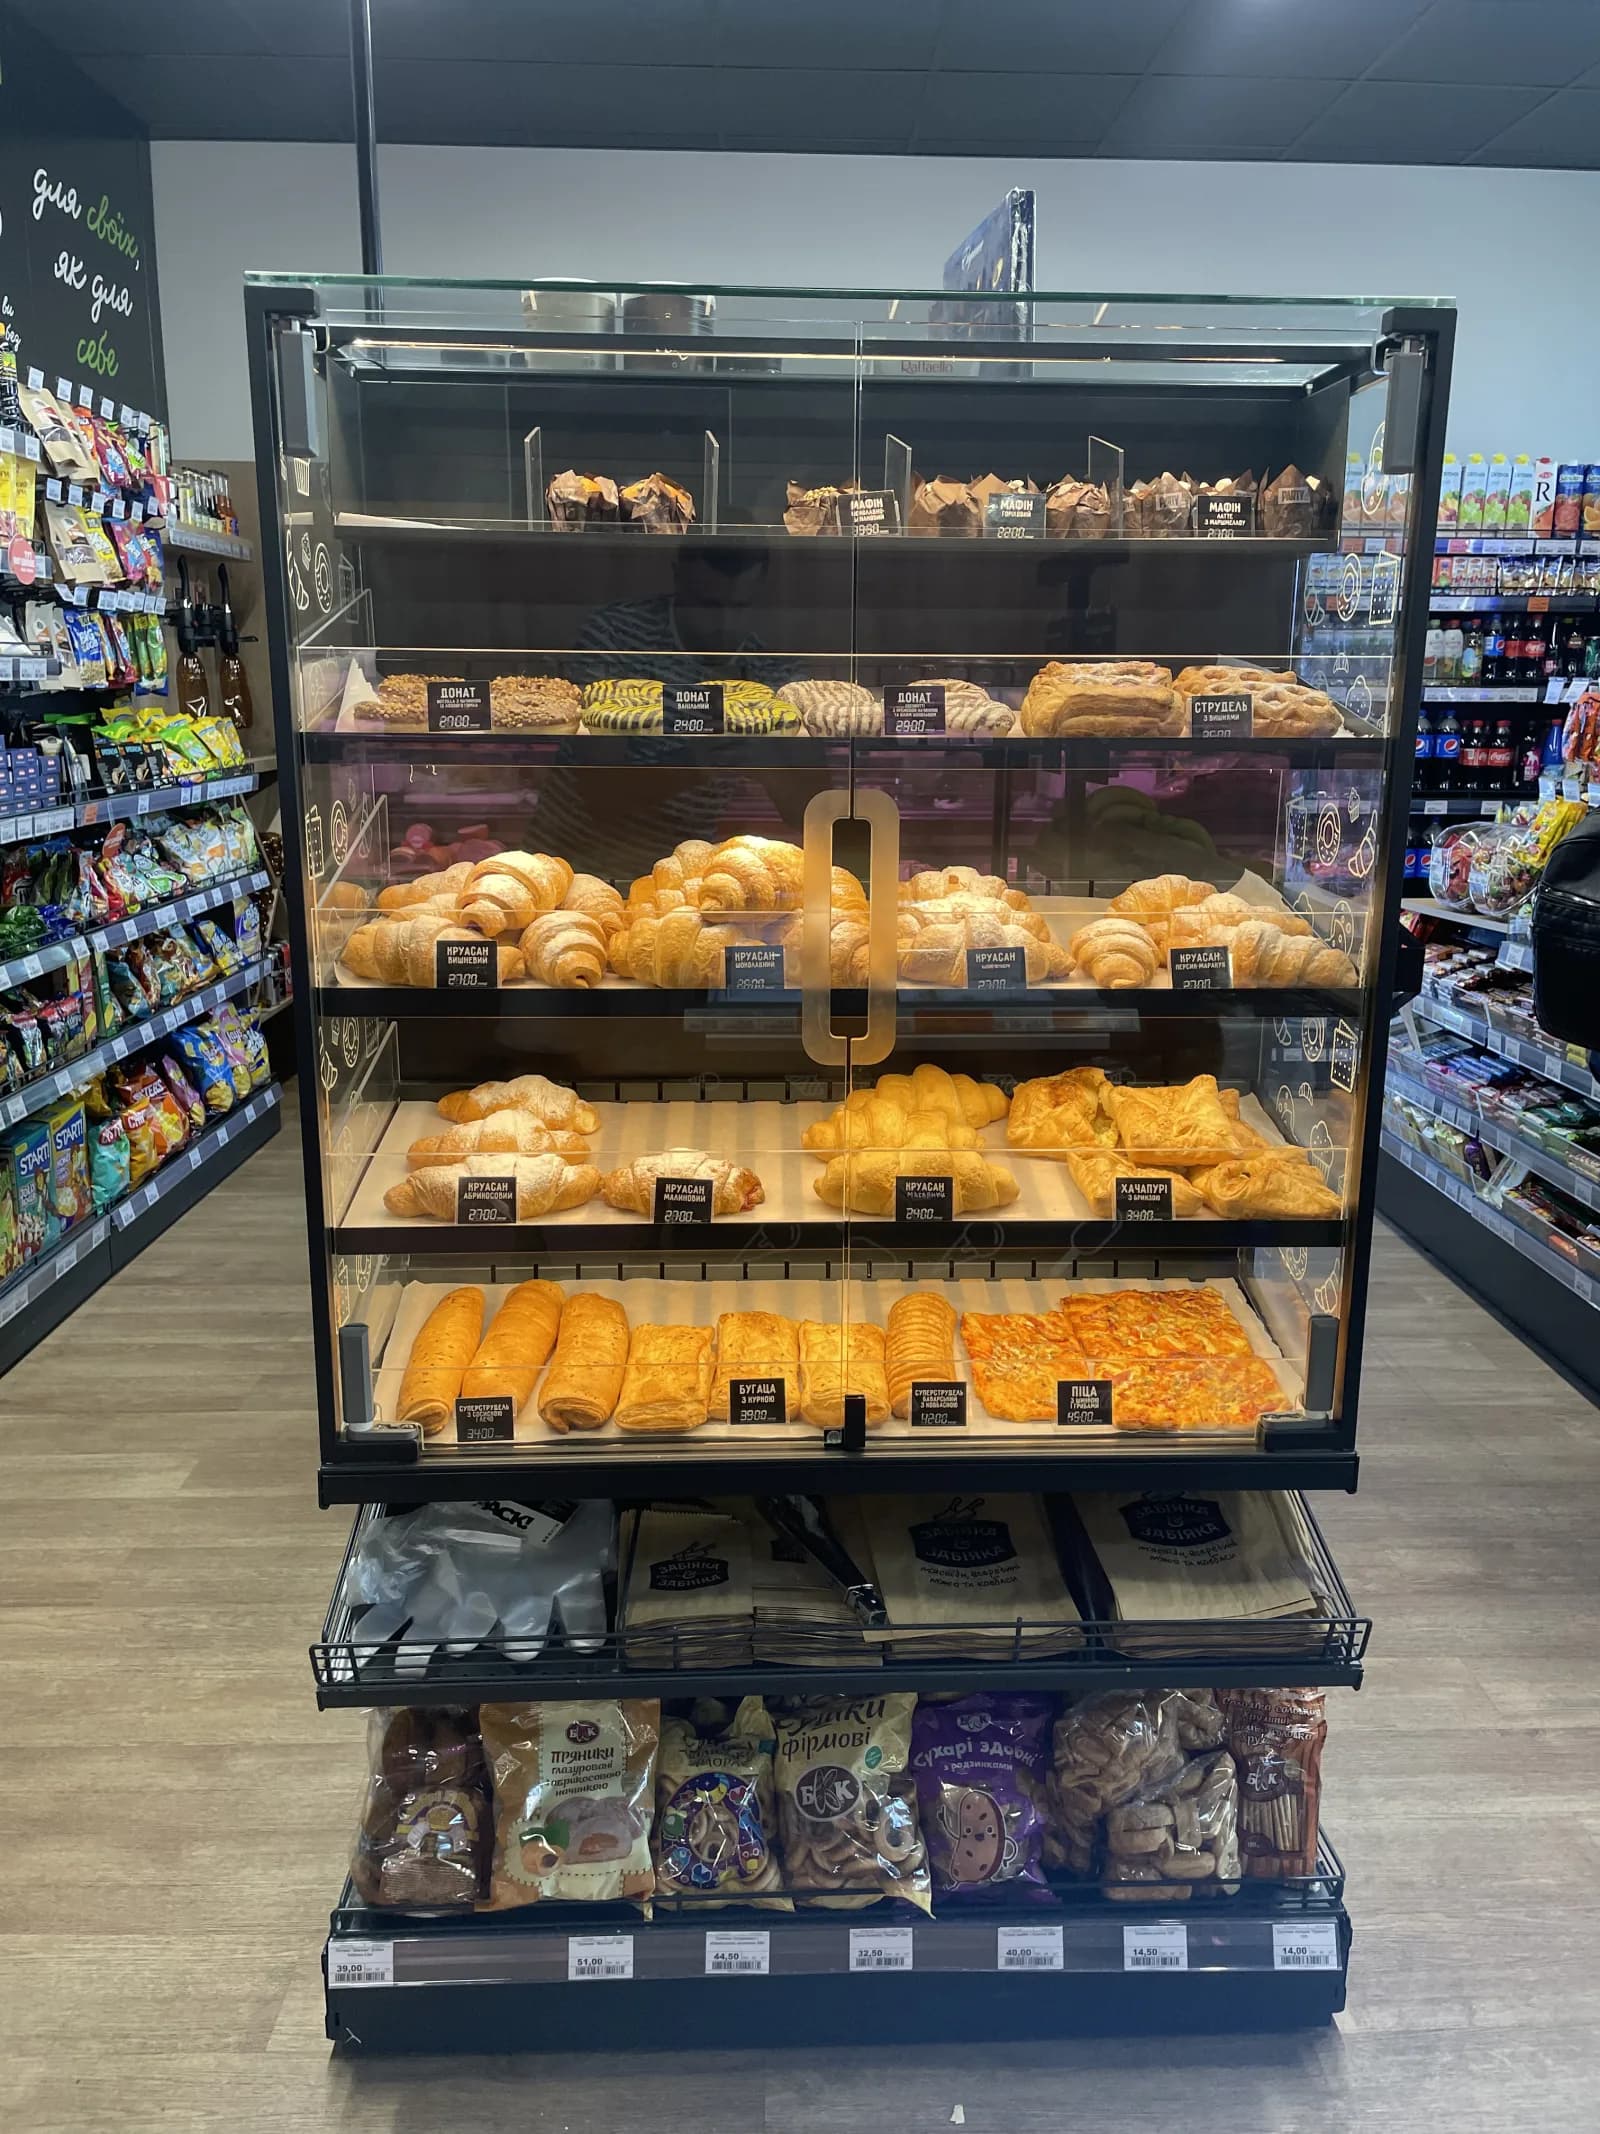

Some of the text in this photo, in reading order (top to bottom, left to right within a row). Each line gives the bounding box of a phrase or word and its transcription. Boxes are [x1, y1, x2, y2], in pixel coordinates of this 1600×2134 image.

[33, 168, 82, 221] для
[54, 251, 133, 323] як для
[76, 329, 119, 377] себе
[1000, 499, 1034, 511] МАФІН
[1209, 502, 1242, 513] МАФІН
[440, 687, 476, 699] ДОНАТ
[676, 691, 711, 703] ДОНАТ
[897, 692, 932, 704] ДОНАТ
[1194, 701, 1248, 714] СТРУДЕЛЬ
[446, 946, 489, 957] КРУАСАН
[734, 951, 776, 962] КРУАСАН
[975, 951, 1016, 963] КРУАСАН
[1179, 952, 1221, 964] КРУАСАН
[468, 1182, 509, 1192] КРУАСАН
[665, 1183, 705, 1195] КРУАСАН
[905, 1181, 945, 1193] КРУАСАН
[1120, 1183, 1168, 1194] ХАЧАПУРІ
[739, 1384, 777, 1395] БУГАЦА
[1071, 1385, 1098, 1397] ПІЦА
[713, 1952, 740, 1962] 44,50
[1133, 1948, 1158, 1958] 14,50
[1282, 1946, 1307, 1956] 14,00
